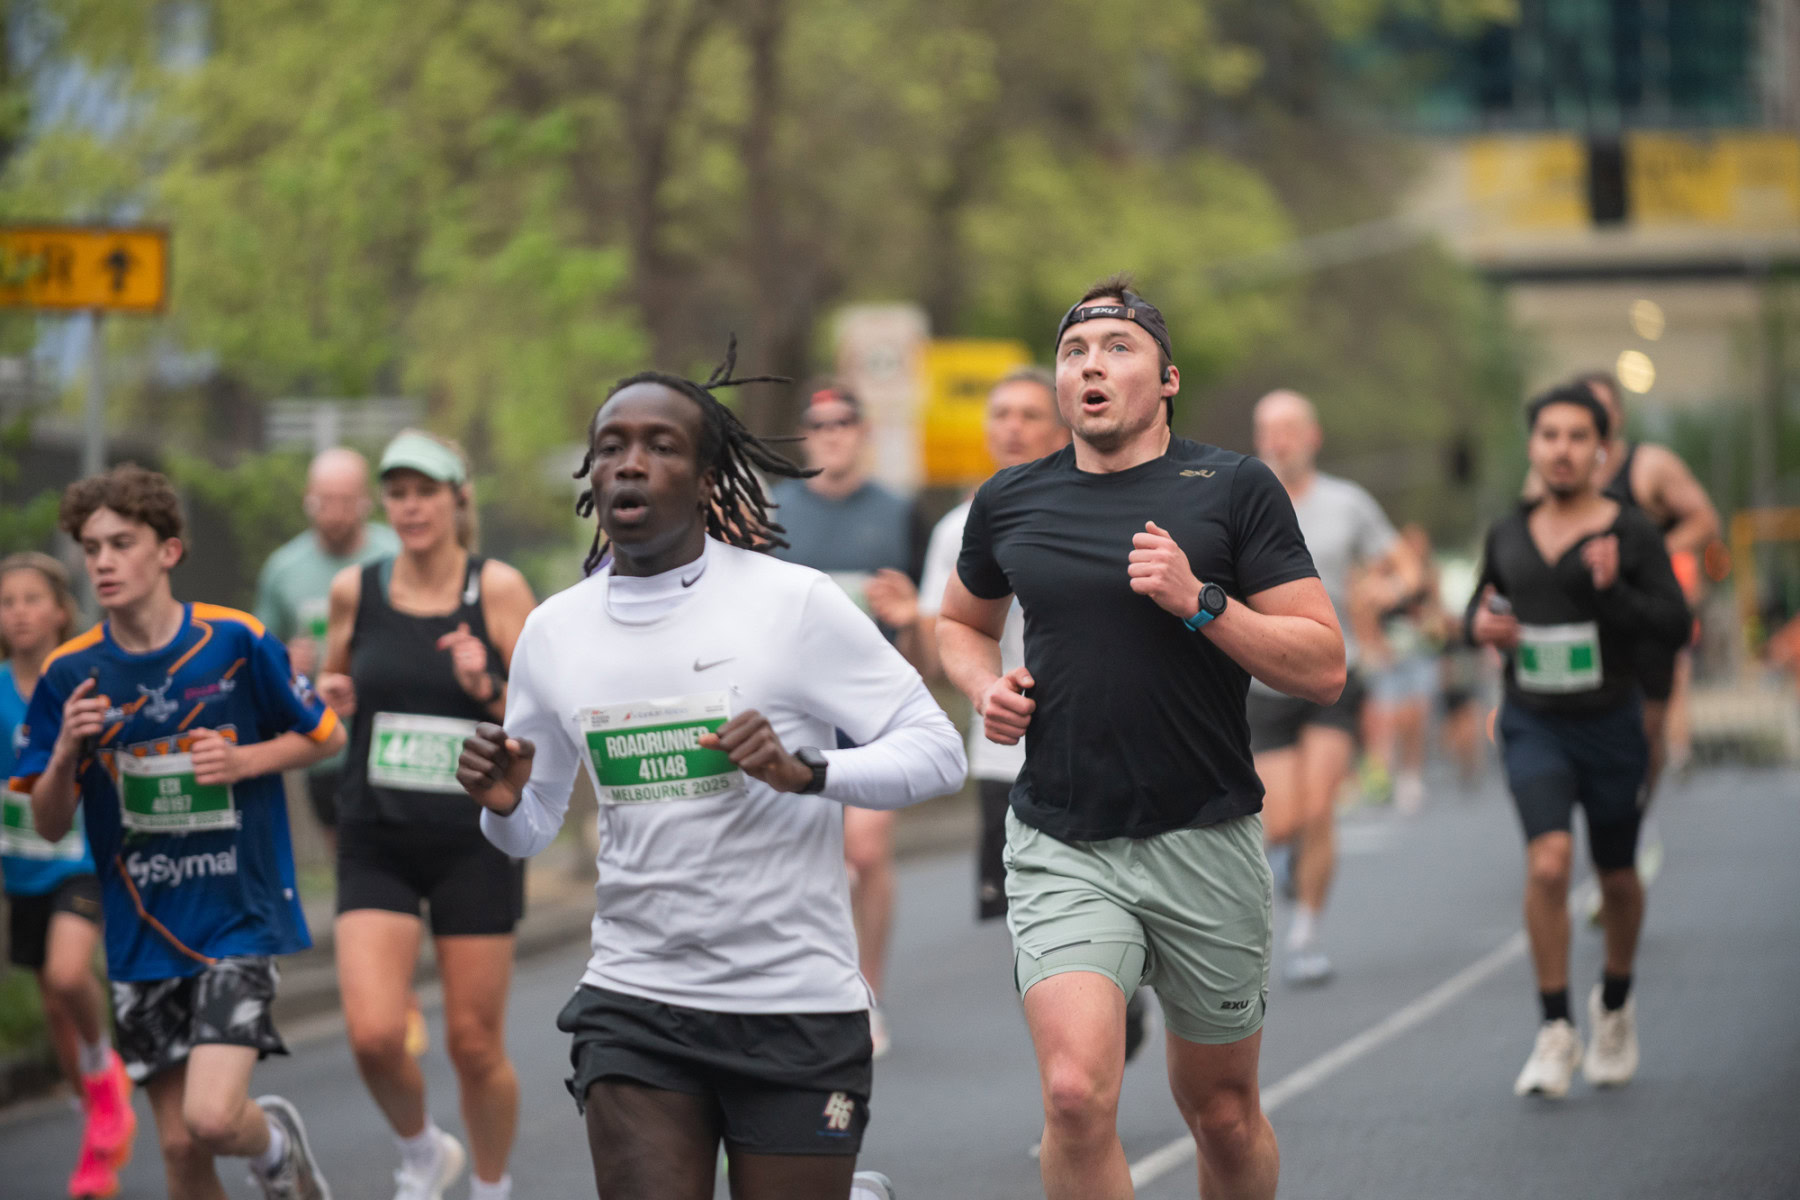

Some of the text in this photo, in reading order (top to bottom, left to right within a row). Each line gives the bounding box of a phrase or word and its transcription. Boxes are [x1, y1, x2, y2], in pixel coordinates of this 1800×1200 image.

[639, 754, 688, 780] 41148
[611, 776, 730, 801] MELBOURNE 2025
[150, 845, 238, 887] Symal
[1220, 1000, 1249, 1009] 2XU
